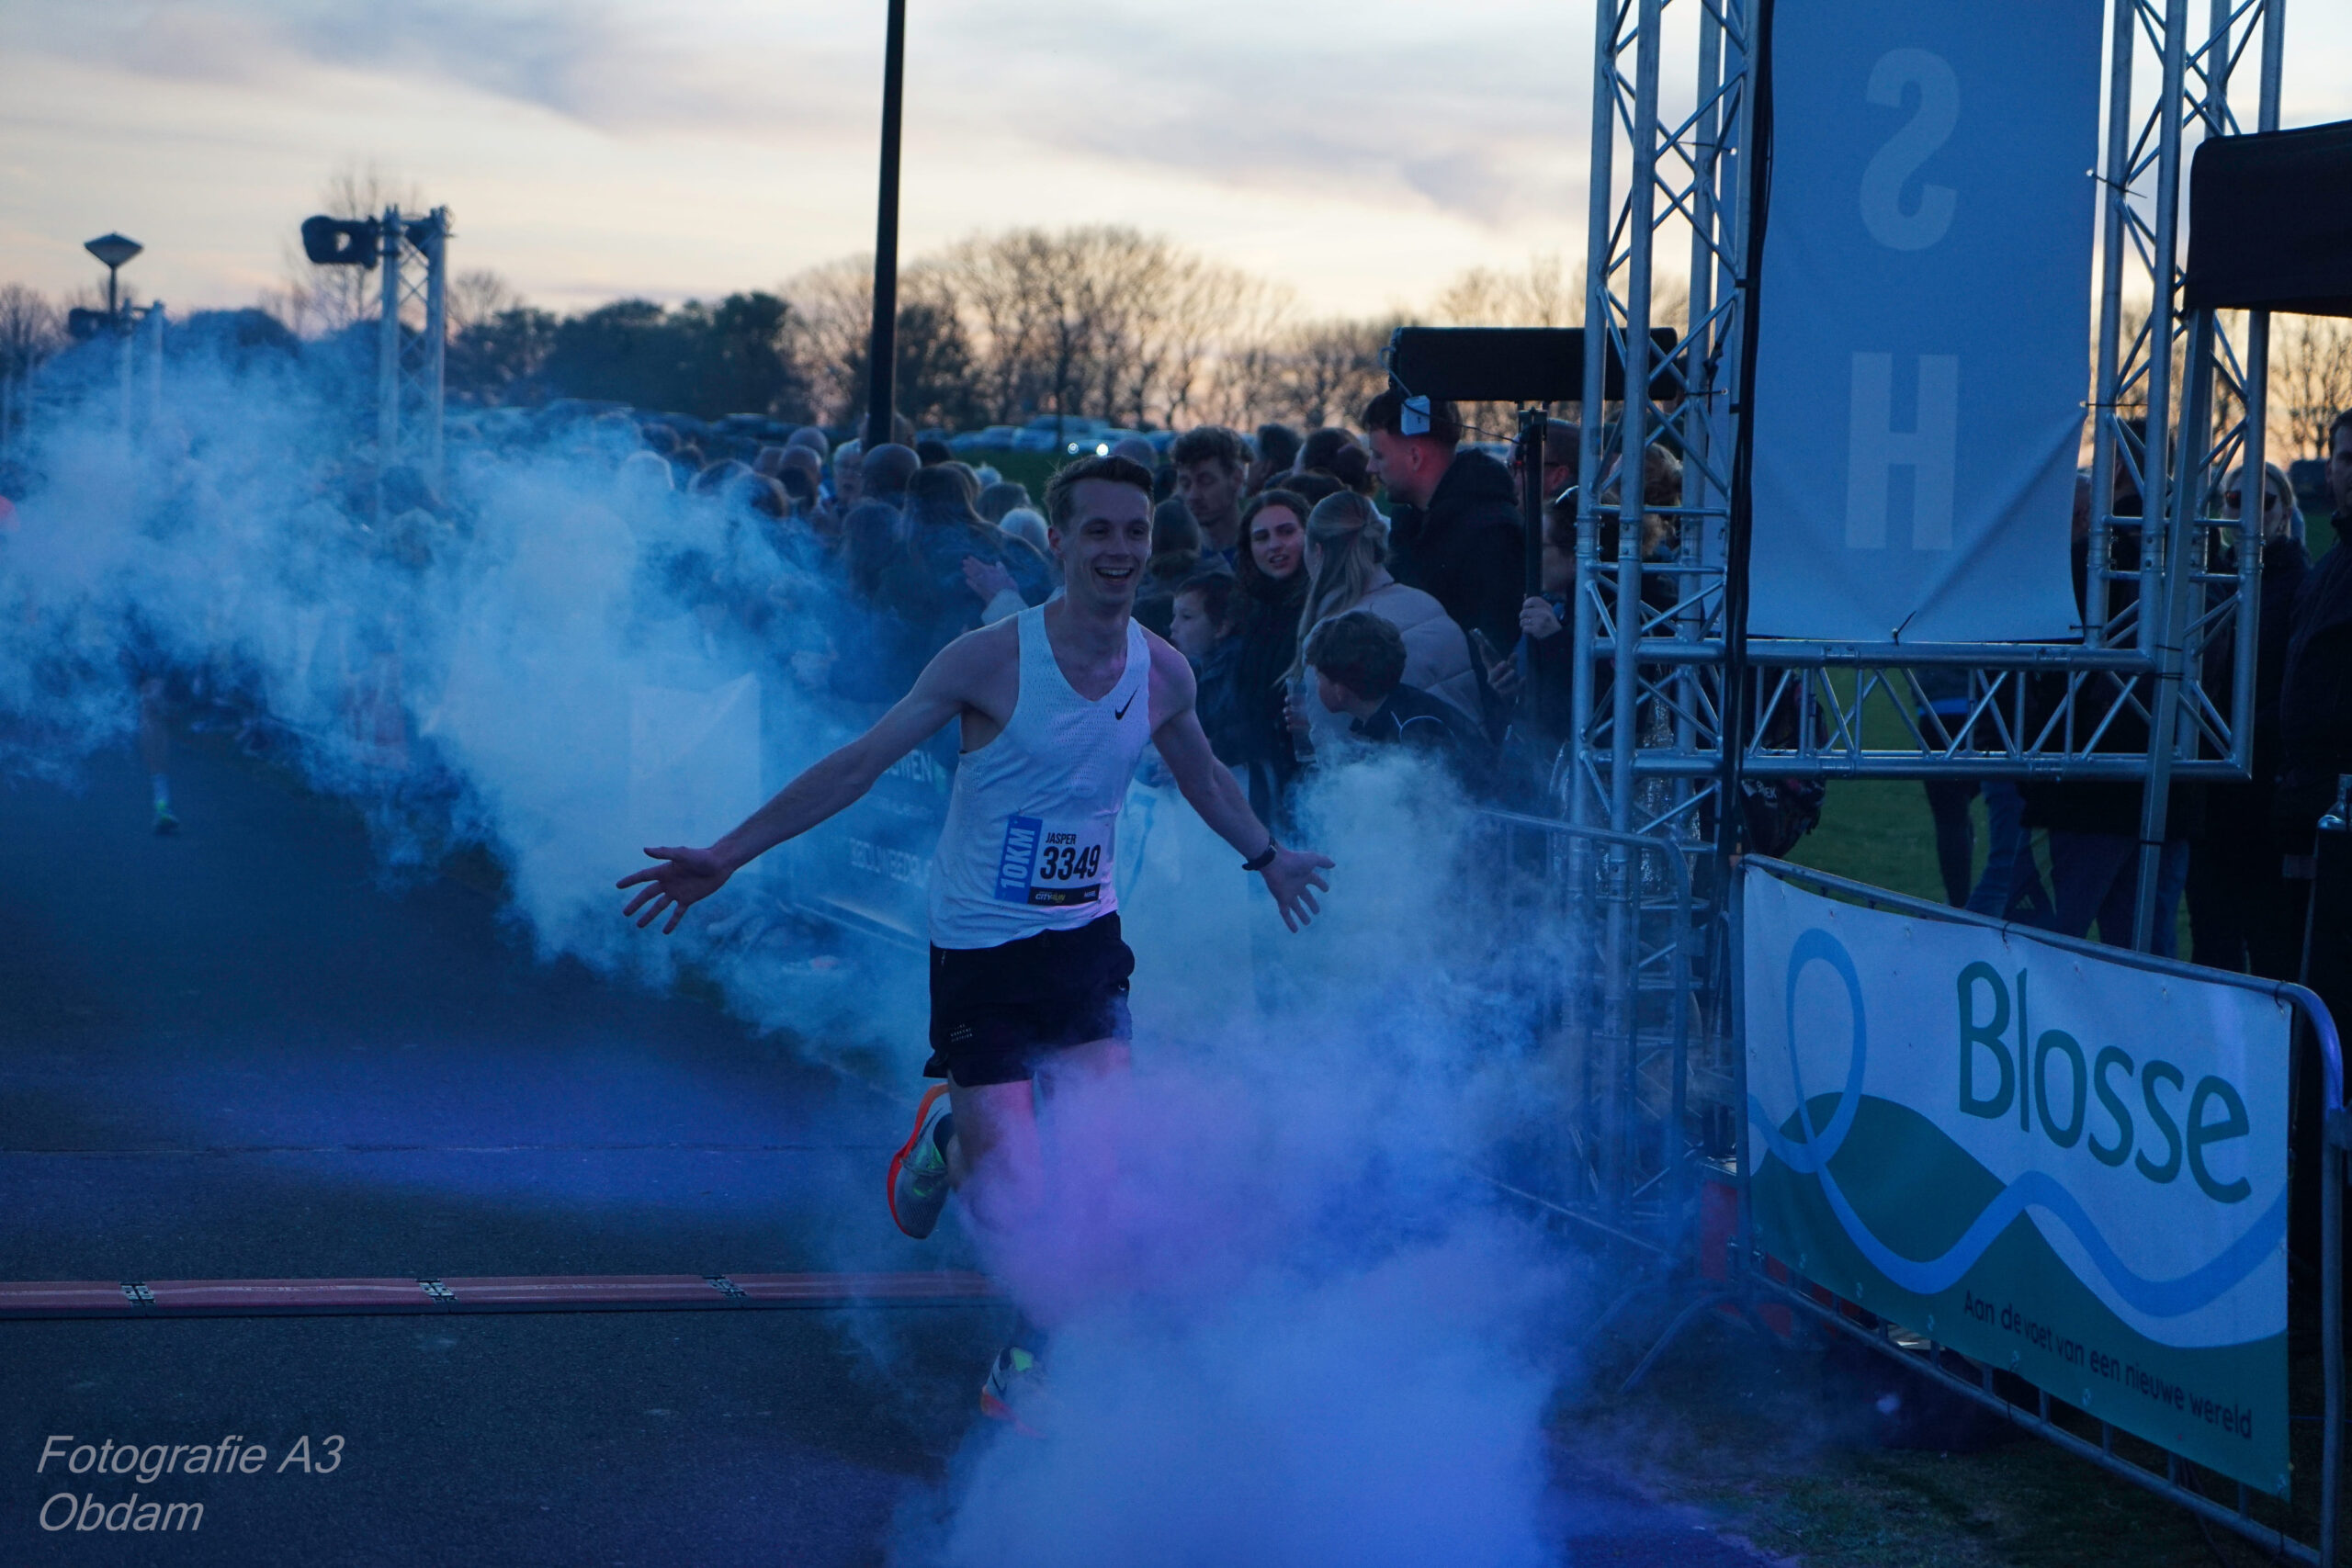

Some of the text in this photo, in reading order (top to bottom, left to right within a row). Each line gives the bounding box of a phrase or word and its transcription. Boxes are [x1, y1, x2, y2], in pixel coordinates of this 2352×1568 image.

[1001, 828, 1035, 888] 10KM
[1040, 844, 1102, 881] 3349
[1046, 832, 1077, 845] JASPER
[1956, 961, 2252, 1203] Blosse
[1964, 1289, 2253, 1439] Aan de voet van een nieuwe wereld
